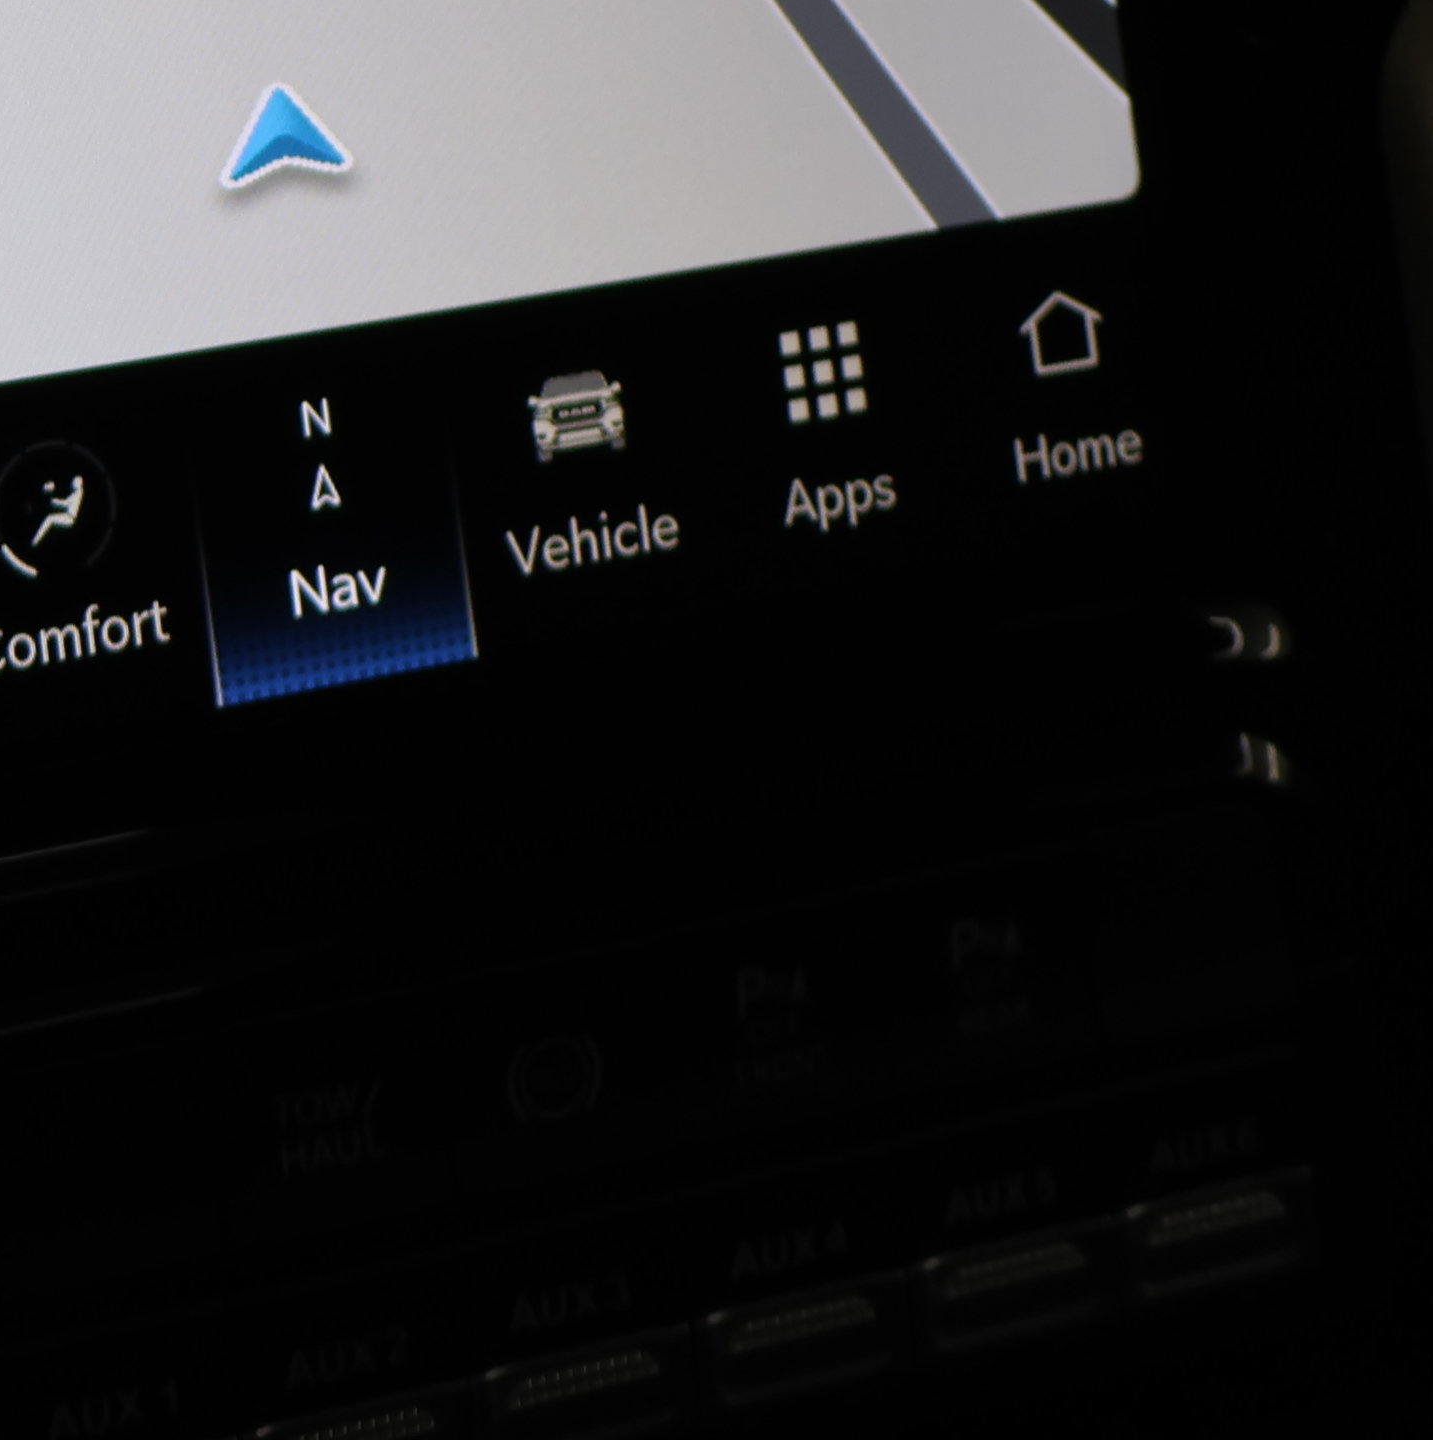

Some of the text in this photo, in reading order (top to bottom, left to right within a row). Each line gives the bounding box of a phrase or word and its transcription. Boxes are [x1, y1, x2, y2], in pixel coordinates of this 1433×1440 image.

[300, 397, 332, 438] N
[1014, 430, 1142, 483] Home
[784, 475, 896, 531] Apps
[506, 504, 679, 575] Vehicle
[289, 564, 386, 617] Nav
